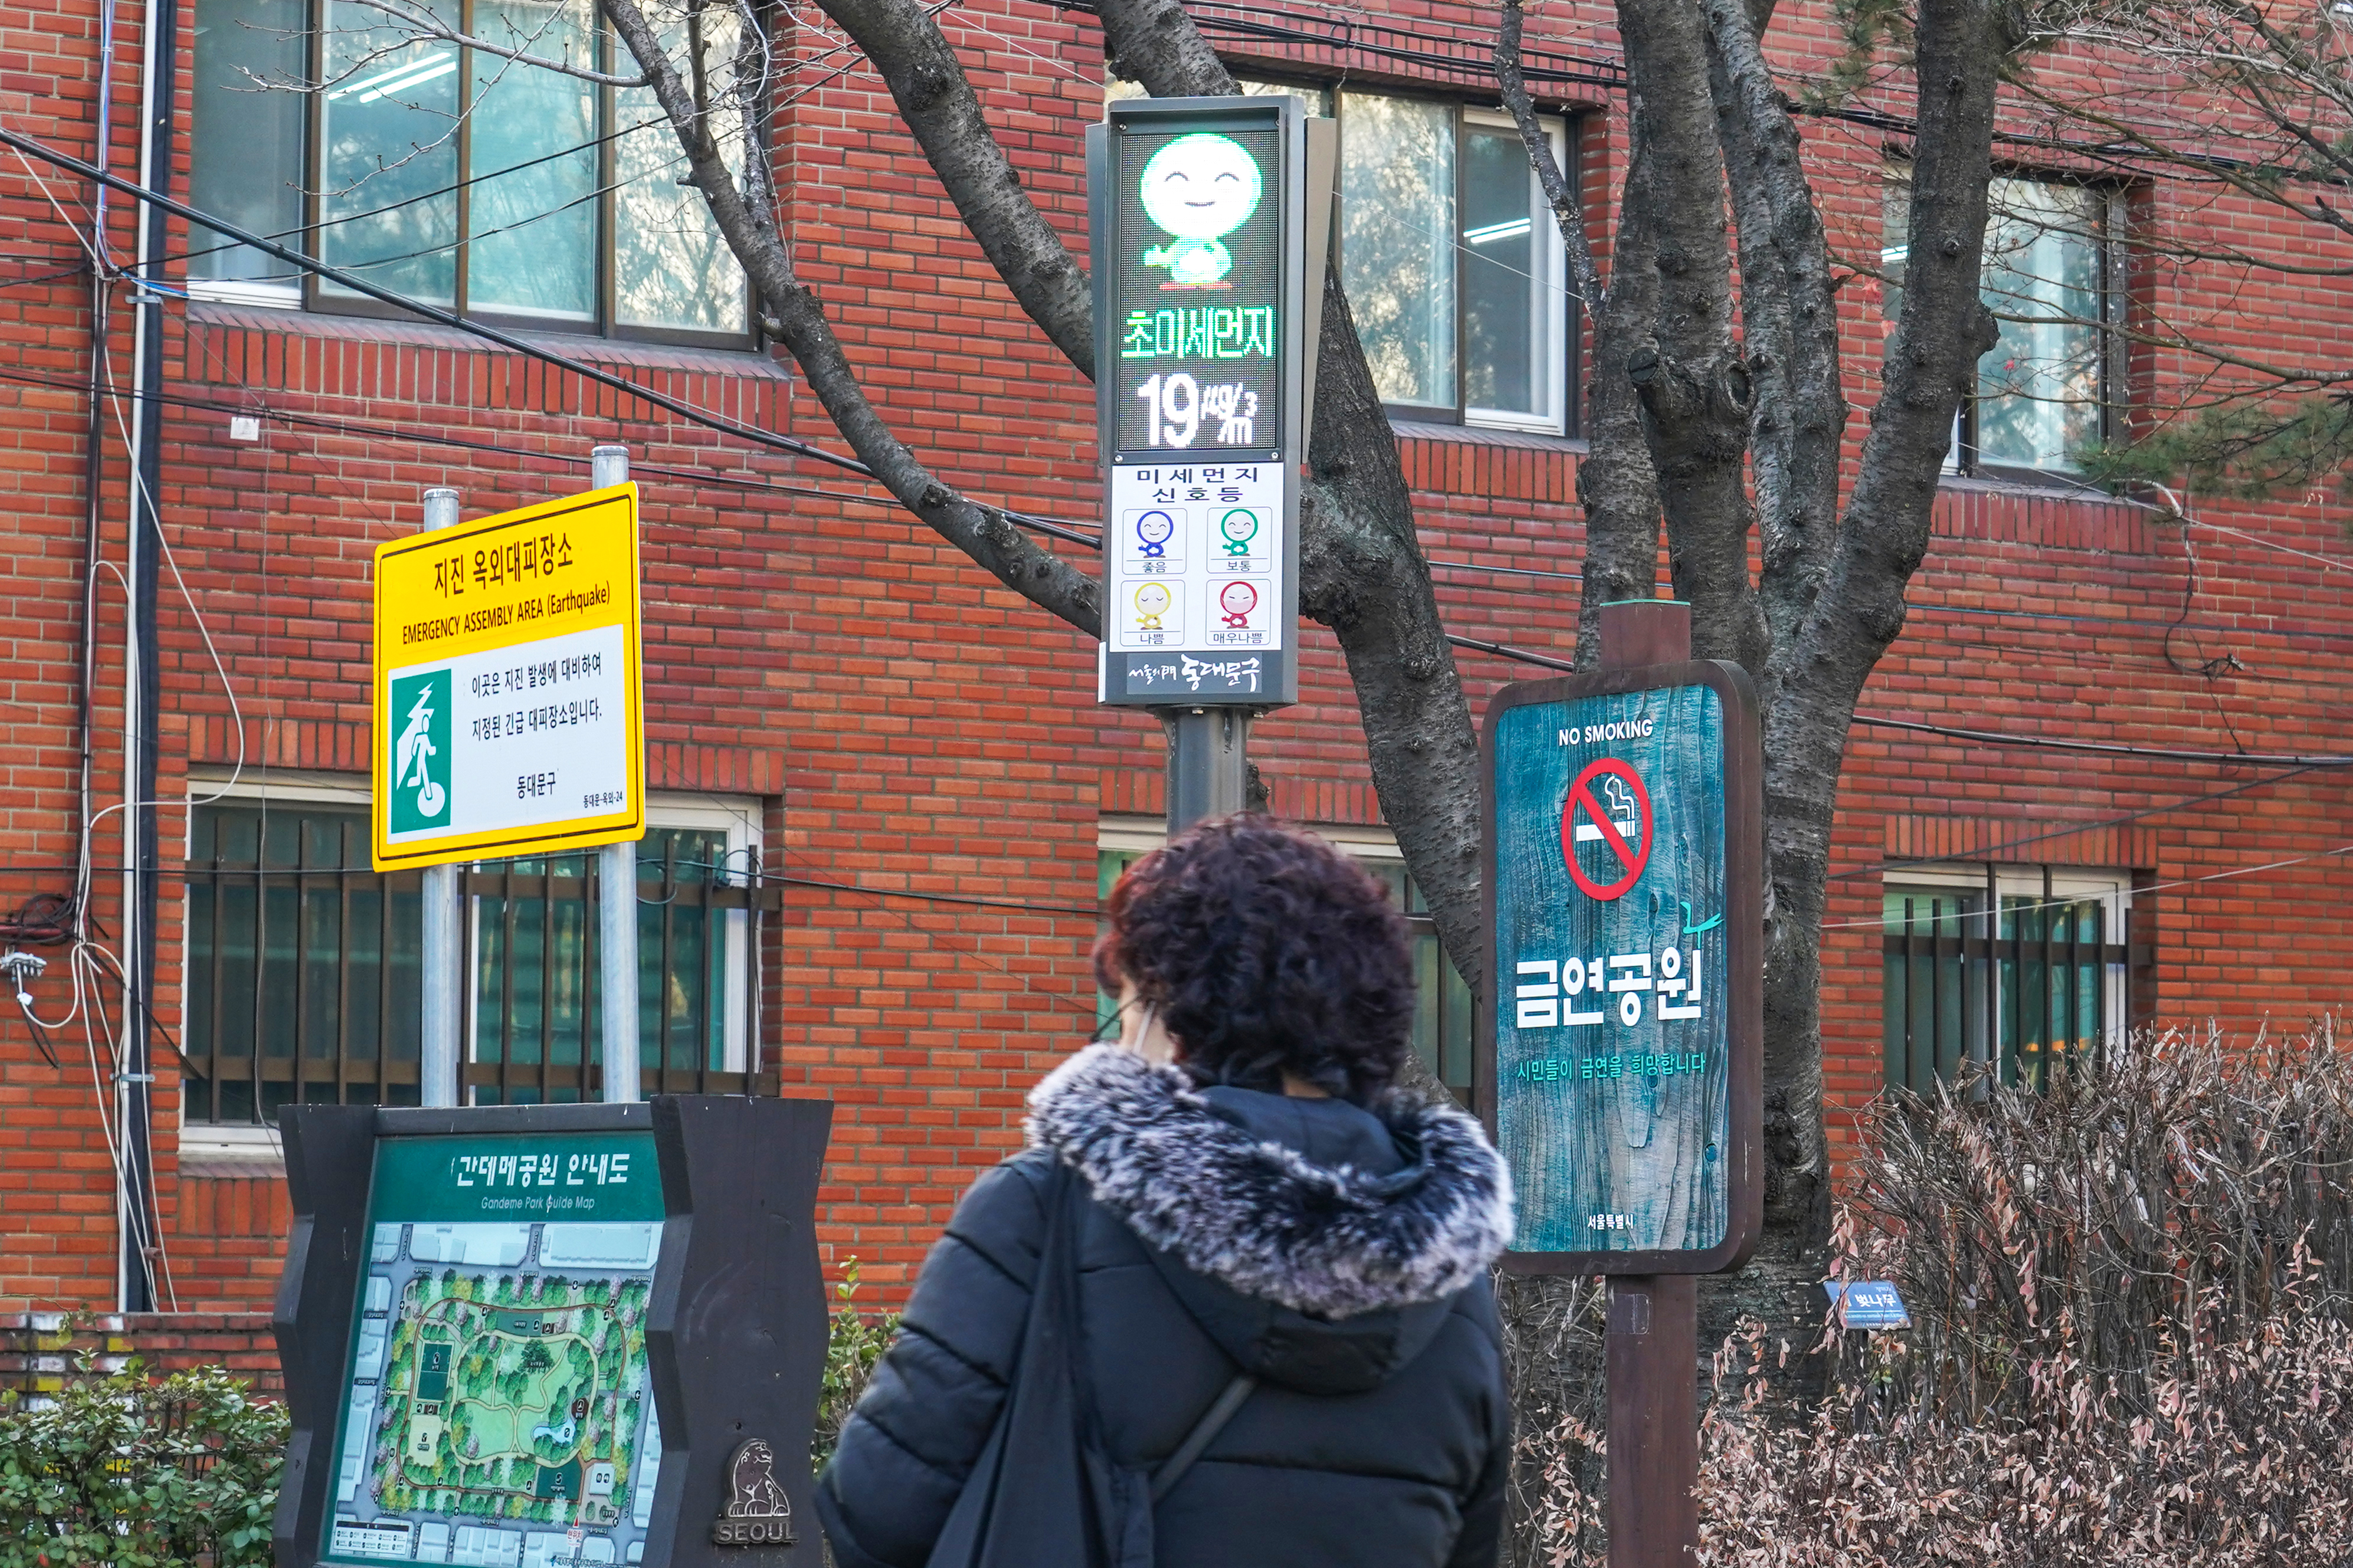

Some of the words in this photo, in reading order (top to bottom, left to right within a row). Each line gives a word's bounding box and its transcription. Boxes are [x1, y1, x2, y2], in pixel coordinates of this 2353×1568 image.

[1121, 305, 1274, 359] 초미세먼지
[1136, 372, 1199, 448] 19
[1136, 467, 1257, 484] 미세먼지
[1152, 487, 1244, 503] 신호등
[434, 553, 464, 599] 지진
[473, 532, 573, 590] 옥외대피장소
[1142, 561, 1167, 573] 좋음
[1227, 560, 1251, 572] 보통
[402, 615, 460, 645] EMERGENCY
[463, 603, 514, 634] ASSEMBLY
[517, 598, 544, 623] AREA
[546, 580, 611, 618] (Earthquake)
[1140, 633, 1165, 645] 나쁨
[1213, 632, 1263, 644] 매우나쁨
[472, 671, 500, 698] 이곳은
[504, 667, 523, 693] 지진
[527, 660, 558, 688] 발생에
[561, 651, 602, 681] 대비하여
[1181, 653, 1260, 693] 동대문구
[472, 715, 500, 742] 지정된
[505, 710, 525, 737] 긴급
[529, 697, 602, 733] 대피장소입니다.
[1558, 727, 1581, 746] NO
[1584, 718, 1653, 744] SMOKING
[516, 772, 556, 799] 동대문구
[1516, 946, 1702, 1029] 금연공원
[1517, 1058, 1572, 1082] 시민들이
[1580, 1056, 1623, 1080] 금연을
[1630, 1052, 1706, 1077] 희망합니다
[457, 1153, 559, 1188] 간데메공원
[566, 1153, 631, 1186] 안내도
[481, 1196, 523, 1211] Gandeme
[525, 1196, 544, 1210] Park
[546, 1194, 573, 1211] Guide
[575, 1195, 595, 1212] Map
[1587, 1213, 1634, 1231] 서울특별시
[716, 1522, 798, 1543] SEOUL
